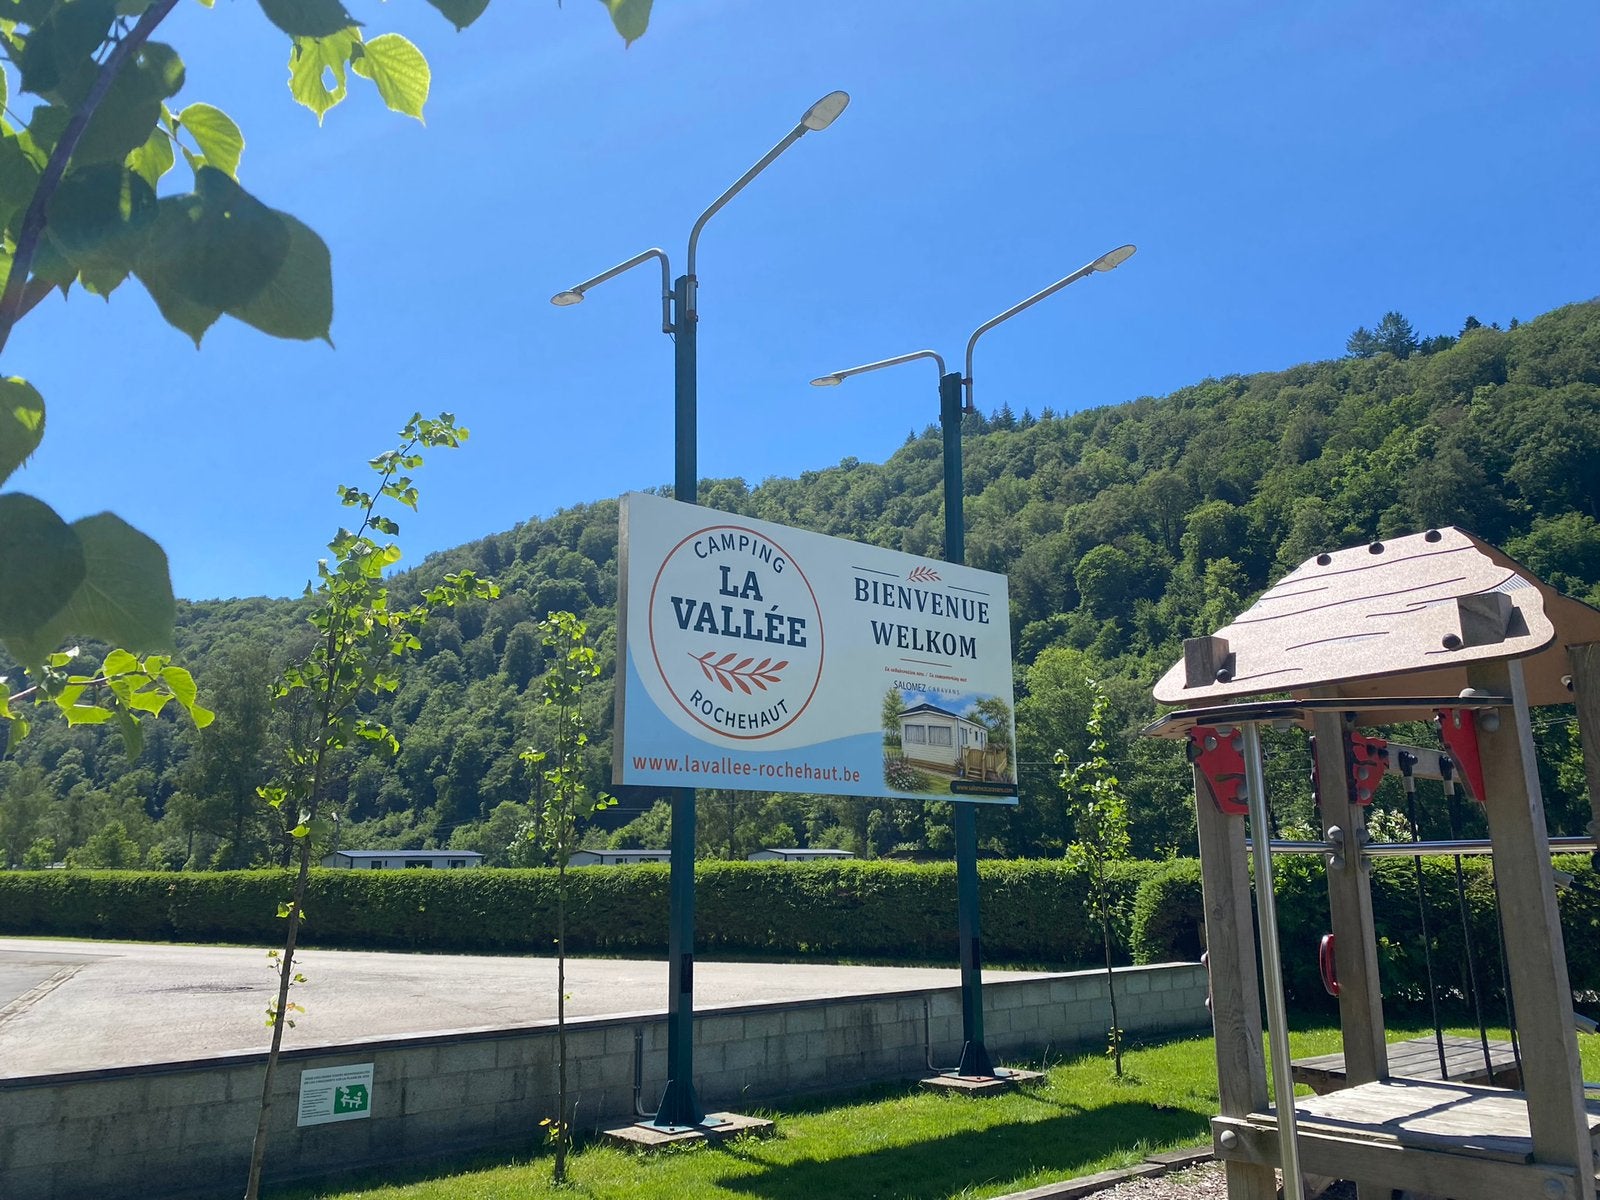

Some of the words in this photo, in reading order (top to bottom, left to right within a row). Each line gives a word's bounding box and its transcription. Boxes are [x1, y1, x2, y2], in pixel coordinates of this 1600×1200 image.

[694, 533, 787, 574] CAMPING
[719, 565, 764, 602] LA
[854, 577, 990, 624] BIENVENUE
[670, 596, 807, 648] VALLÉE
[870, 620, 977, 660] WELKOM
[893, 680, 927, 693] SALOMEZ
[927, 686, 960, 696] CARAVANS
[690, 690, 790, 730] ROCHEHAUT
[632, 754, 861, 783] www.lavallee-rochehaut.be
